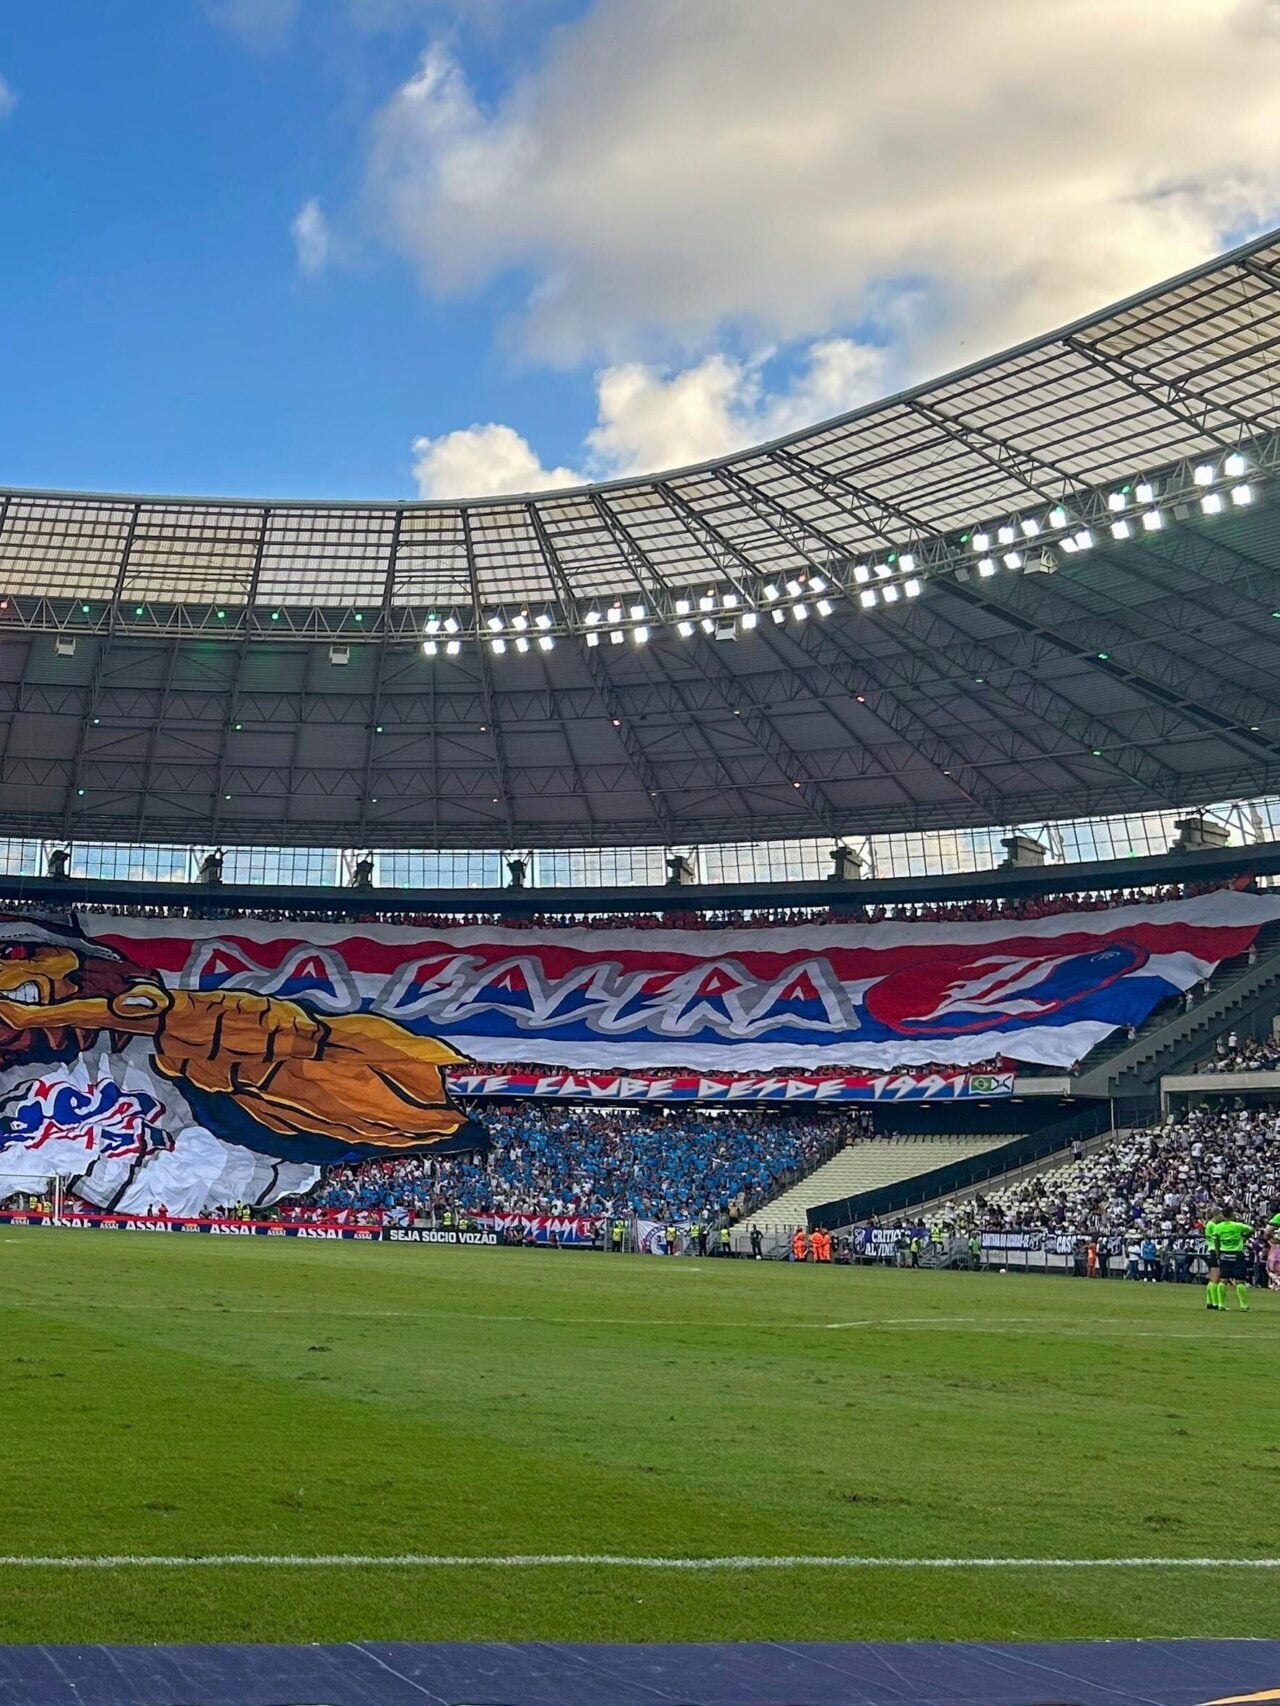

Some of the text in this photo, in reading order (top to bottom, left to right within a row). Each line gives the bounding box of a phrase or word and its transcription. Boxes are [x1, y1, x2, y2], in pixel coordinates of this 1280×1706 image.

[868, 1074, 967, 1099] 1991
[390, 1229, 497, 1244] SEJA SÓCIO VOZÃO
